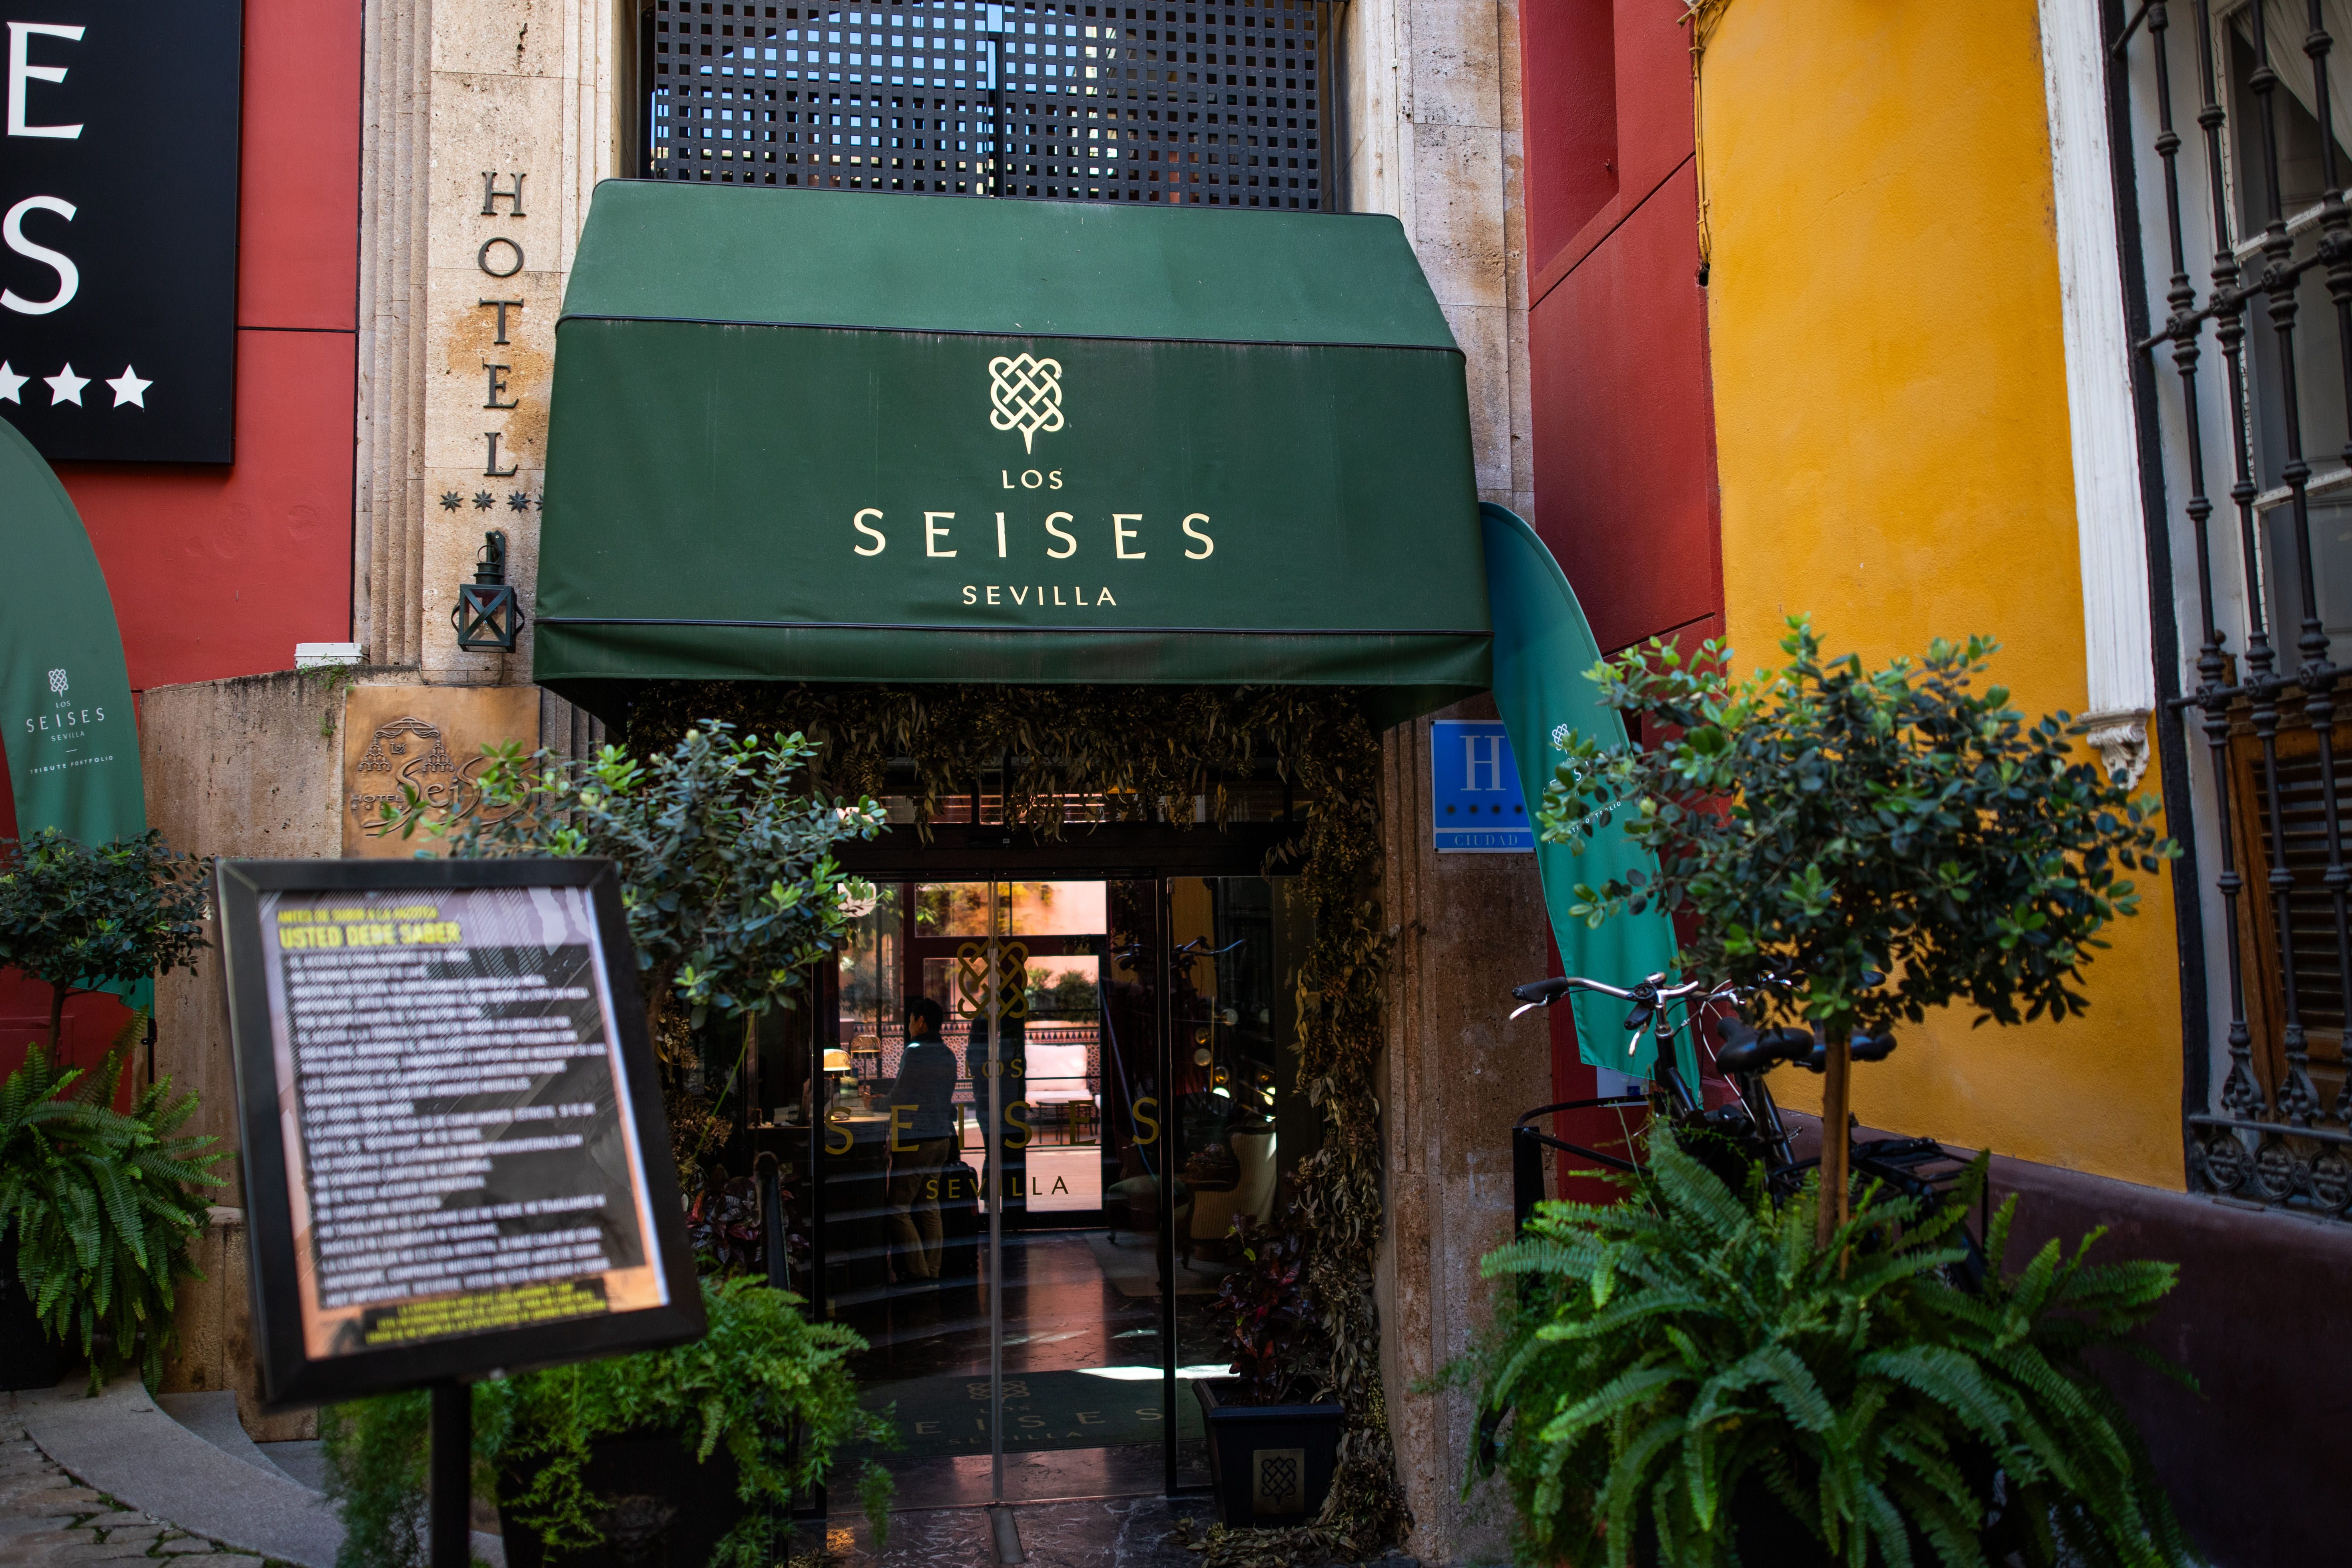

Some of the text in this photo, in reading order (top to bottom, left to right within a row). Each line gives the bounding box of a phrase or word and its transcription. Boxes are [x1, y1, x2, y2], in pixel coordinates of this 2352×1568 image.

[478, 171, 527, 476] HOTEL
[1002, 469, 1063, 490] LOS
[853, 508, 1214, 560] SEISES
[962, 585, 1117, 606] SEVILLA
[56, 700, 71, 708] LOS
[26, 707, 105, 733] SEISES
[51, 731, 85, 742] SEVILLA
[30, 755, 113, 775] TRIBUTE PORTFOLIO
[1459, 735, 1506, 791] H
[350, 795, 404, 803] HOTEL
[1455, 834, 1518, 846] CIUDAD
[279, 922, 462, 949] USTED DEBE SABER
[825, 1096, 1160, 1156] SEISES
[948, 1431, 1083, 1445] SEILLA
